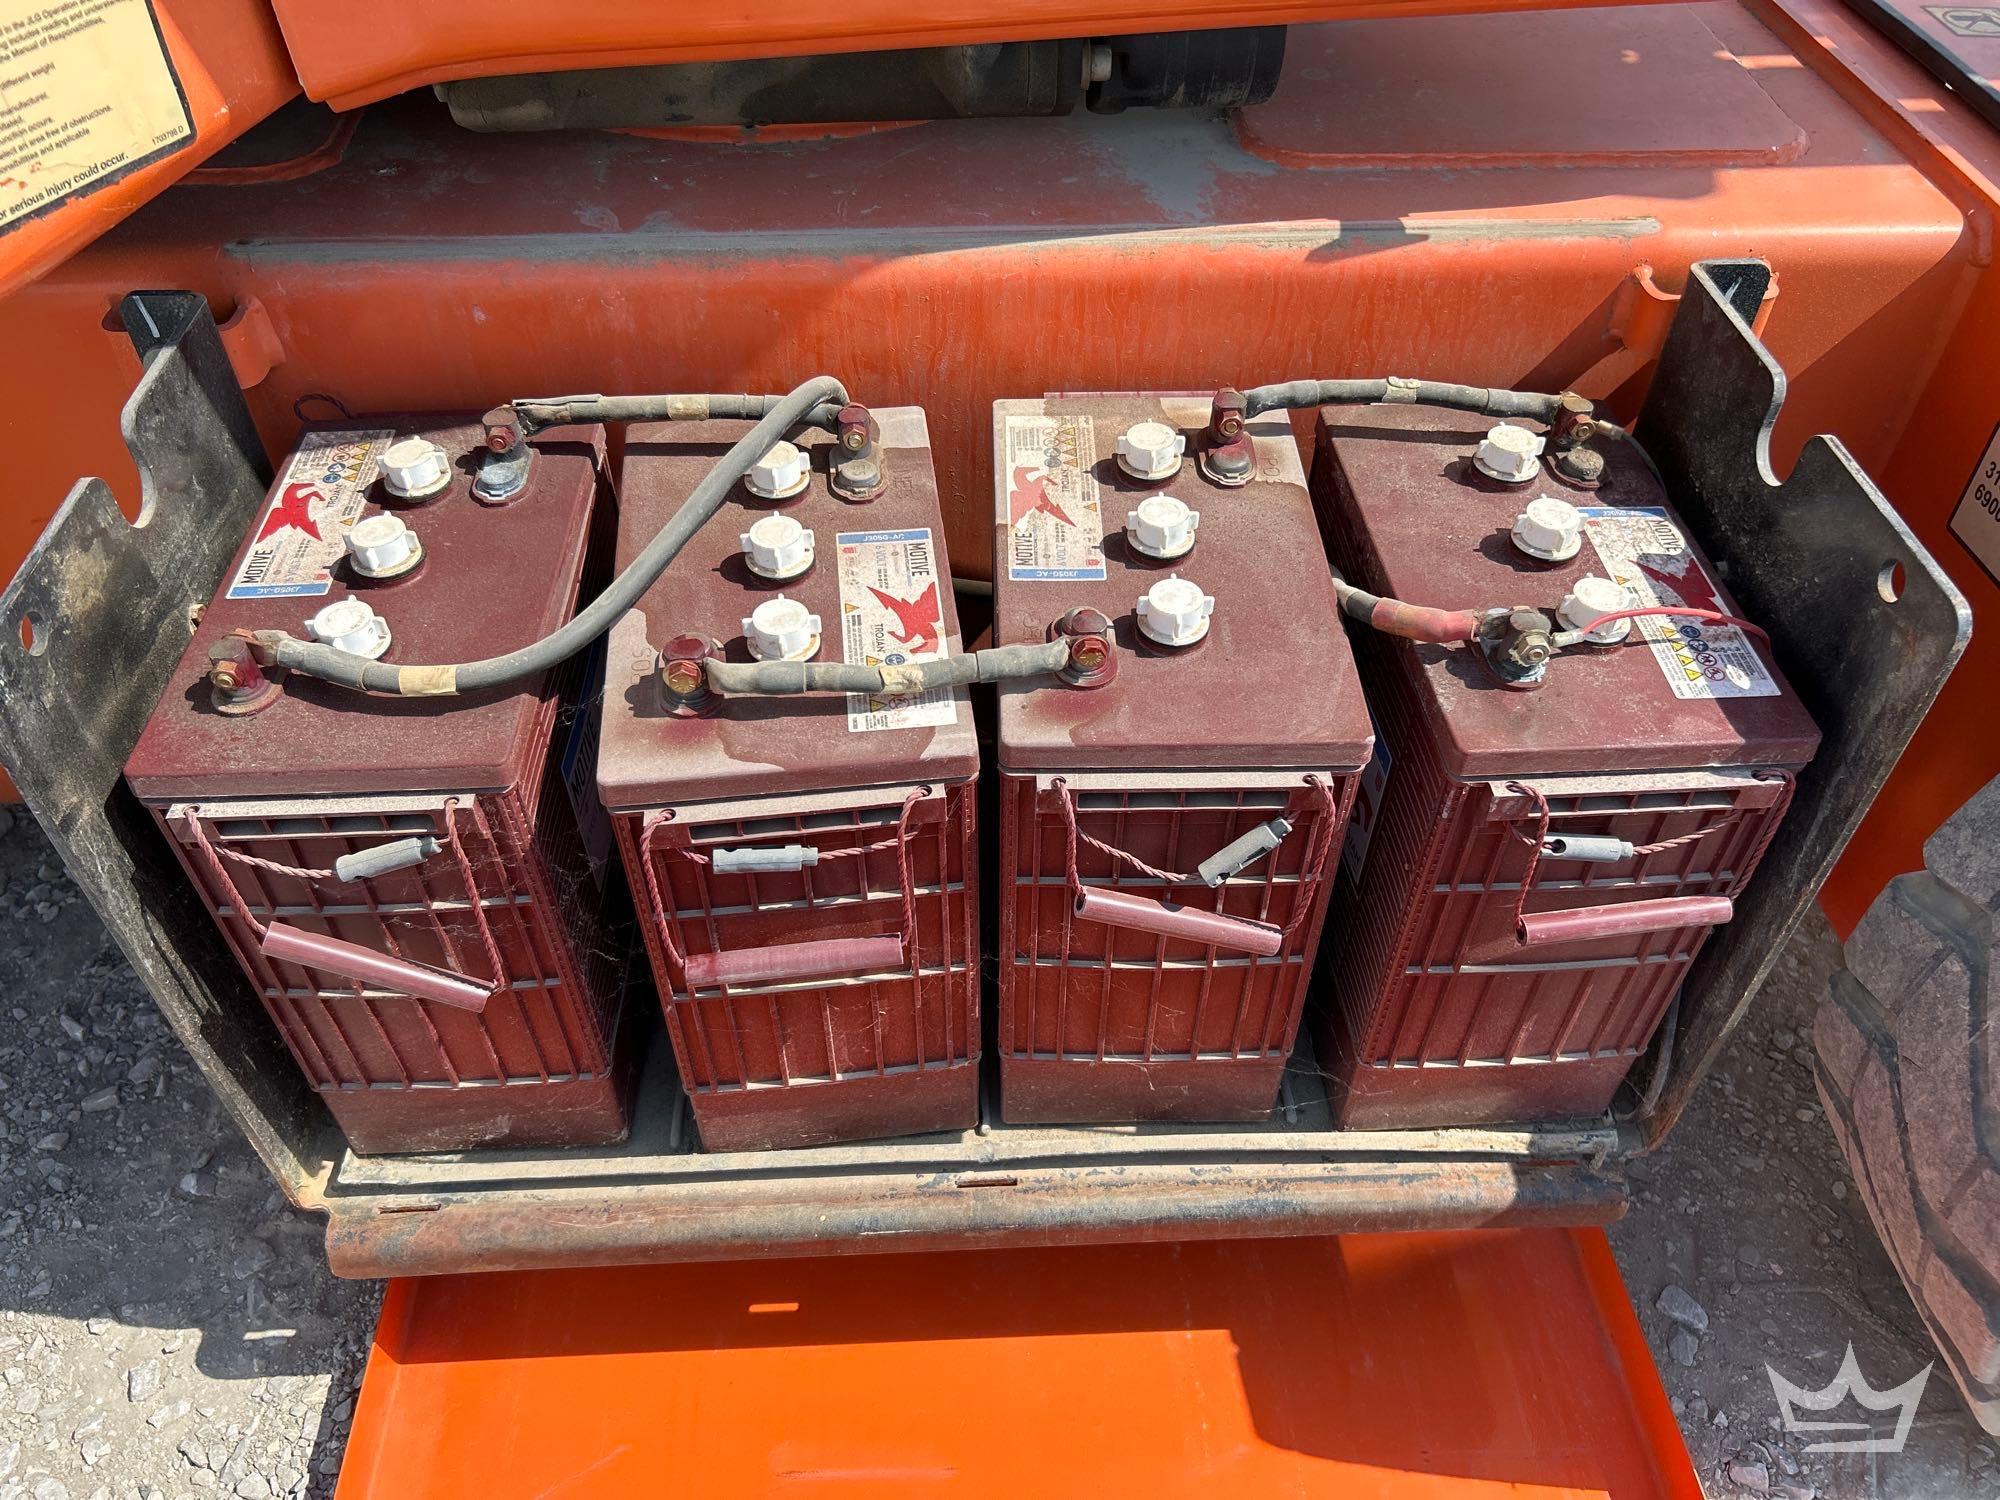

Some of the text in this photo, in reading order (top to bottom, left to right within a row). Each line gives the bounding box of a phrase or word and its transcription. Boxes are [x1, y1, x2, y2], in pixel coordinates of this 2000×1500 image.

[11, 40, 39, 58] Manual
[29, 134, 45, 147] area
[45, 128, 60, 139] free
[60, 122, 69, 132] of
[69, 105, 113, 128] obstructions.
[40, 143, 54, 156] and
[55, 128, 90, 149] applicable
[178, 125, 184, 134] D
[10, 192, 45, 215] serious
[45, 177, 72, 197] injury
[74, 162, 99, 183] could
[101, 151, 129, 170] occur.
[327, 484, 343, 508] TROJAN
[1015, 532, 1033, 566] MOTIVE
[1650, 519, 1684, 553] MOTIVE
[241, 548, 274, 584] MOTIVE
[909, 542, 930, 577] MOTIVE
[874, 623, 886, 653] TROJAN
[571, 711, 597, 797] MOTIVE
